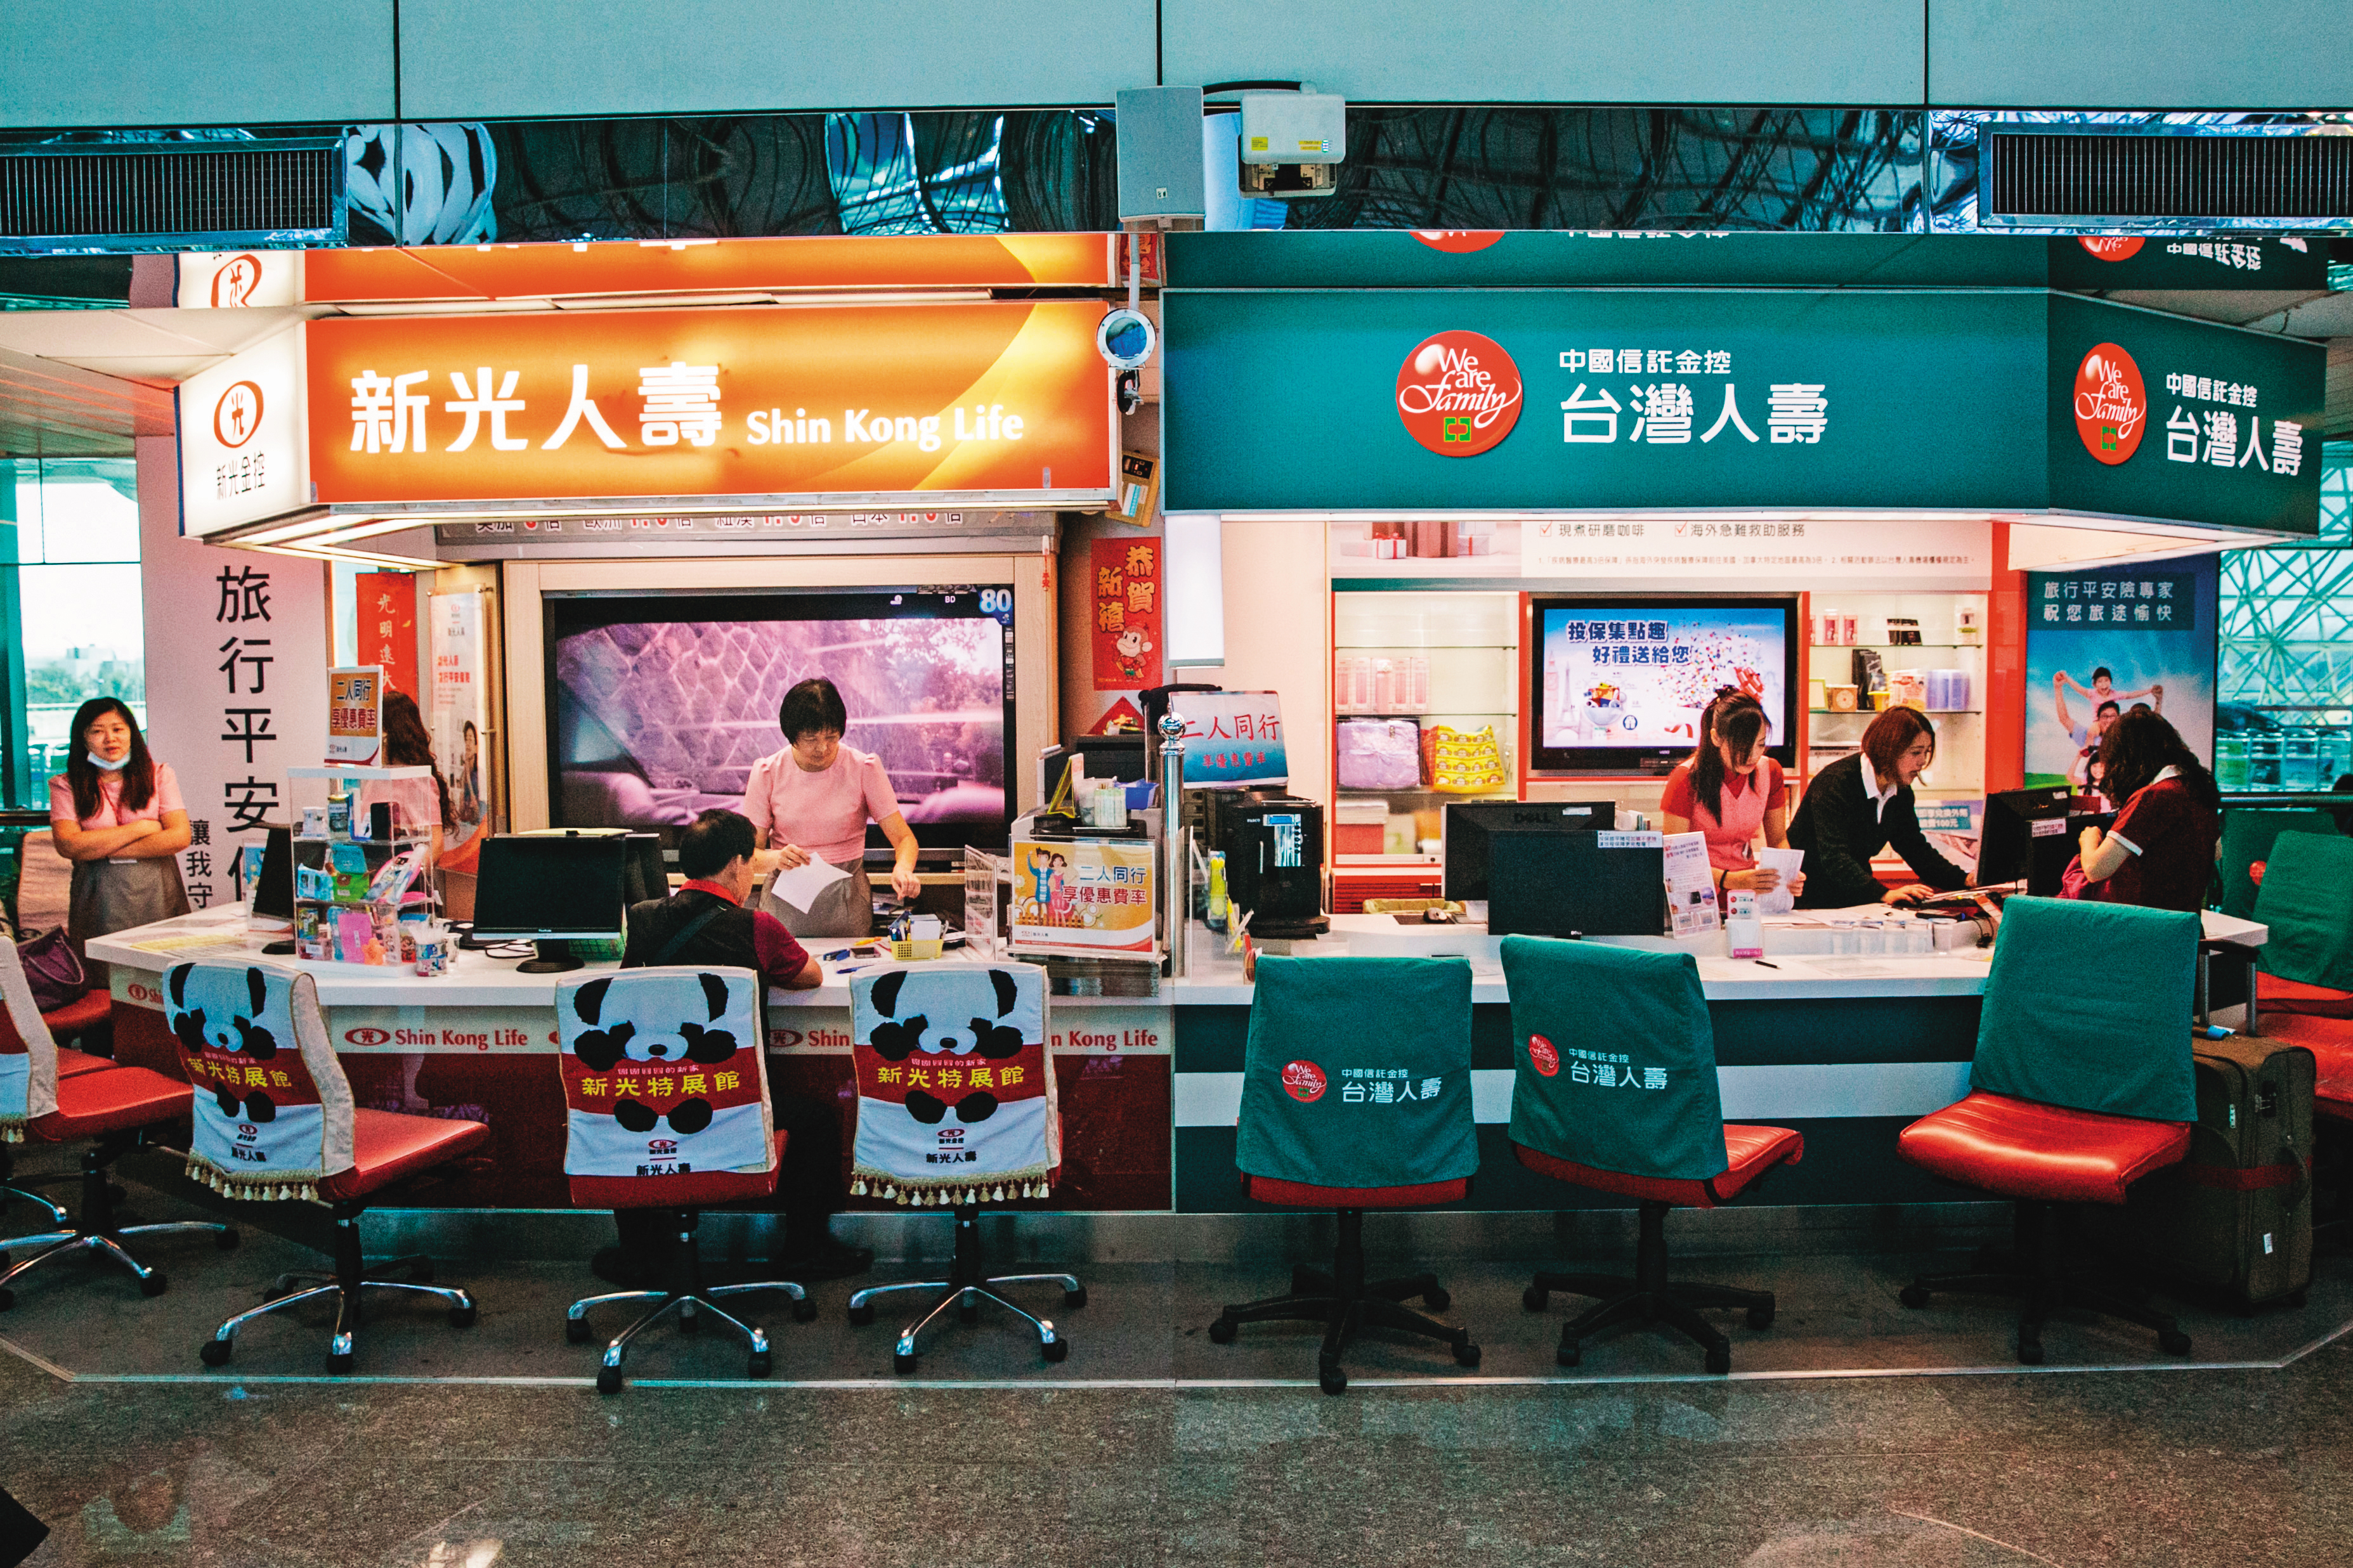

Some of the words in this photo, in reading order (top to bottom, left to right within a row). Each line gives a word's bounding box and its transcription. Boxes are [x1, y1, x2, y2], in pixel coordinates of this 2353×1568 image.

[1436, 348, 1478, 373] We
[1559, 348, 1731, 374] 中國信託金控
[1455, 371, 1491, 388] are
[2097, 360, 2122, 385] We
[2108, 383, 2129, 400] are
[2166, 372, 2257, 408] 中國信託金控
[350, 361, 722, 453] 新光人壽
[1560, 382, 1828, 444] 台灣人壽
[746, 408, 831, 445] Shin
[845, 409, 942, 452] Kong
[955, 404, 1024, 441] Life
[2166, 405, 2304, 477] 台灣人壽
[216, 451, 266, 500] 新光金控
[1559, 524, 1645, 537] 現煮研磨咖啡
[1690, 524, 1804, 537] 海外急難救助服務
[1126, 545, 1154, 613] 恭賀
[2044, 580, 2174, 599] 旅行平安險專家
[980, 589, 1012, 612] 80
[1097, 567, 1125, 632] 新禧
[2043, 604, 2172, 622] 祝您旅途愉快
[1567, 621, 1668, 640] 投保集點趣
[1592, 645, 1691, 664] 好禮送給您
[337, 679, 372, 701] 二人同行
[216, 566, 280, 902] 旅行平安
[1181, 714, 1280, 741] 二人同行
[1079, 866, 1146, 884] 二人同行
[1062, 886, 1147, 904] 享優惠費率
[395, 1030, 436, 1046] Shin
[443, 1030, 488, 1051] Kong
[494, 1030, 528, 1046] Life
[808, 1030, 850, 1046] Shin
[1069, 1031, 1116, 1051] Kong
[1123, 1030, 1157, 1046] Life
[1569, 1048, 1629, 1063] 中國信託金控
[188, 1058, 292, 1087] 新光特展館
[582, 1071, 740, 1097] 新光特展館
[878, 1066, 1024, 1088] 新光特展館
[1342, 1068, 1409, 1079] 中國信託金控
[1570, 1061, 1668, 1089] 台灣人壽
[1342, 1077, 1442, 1103] 台灣人壽
